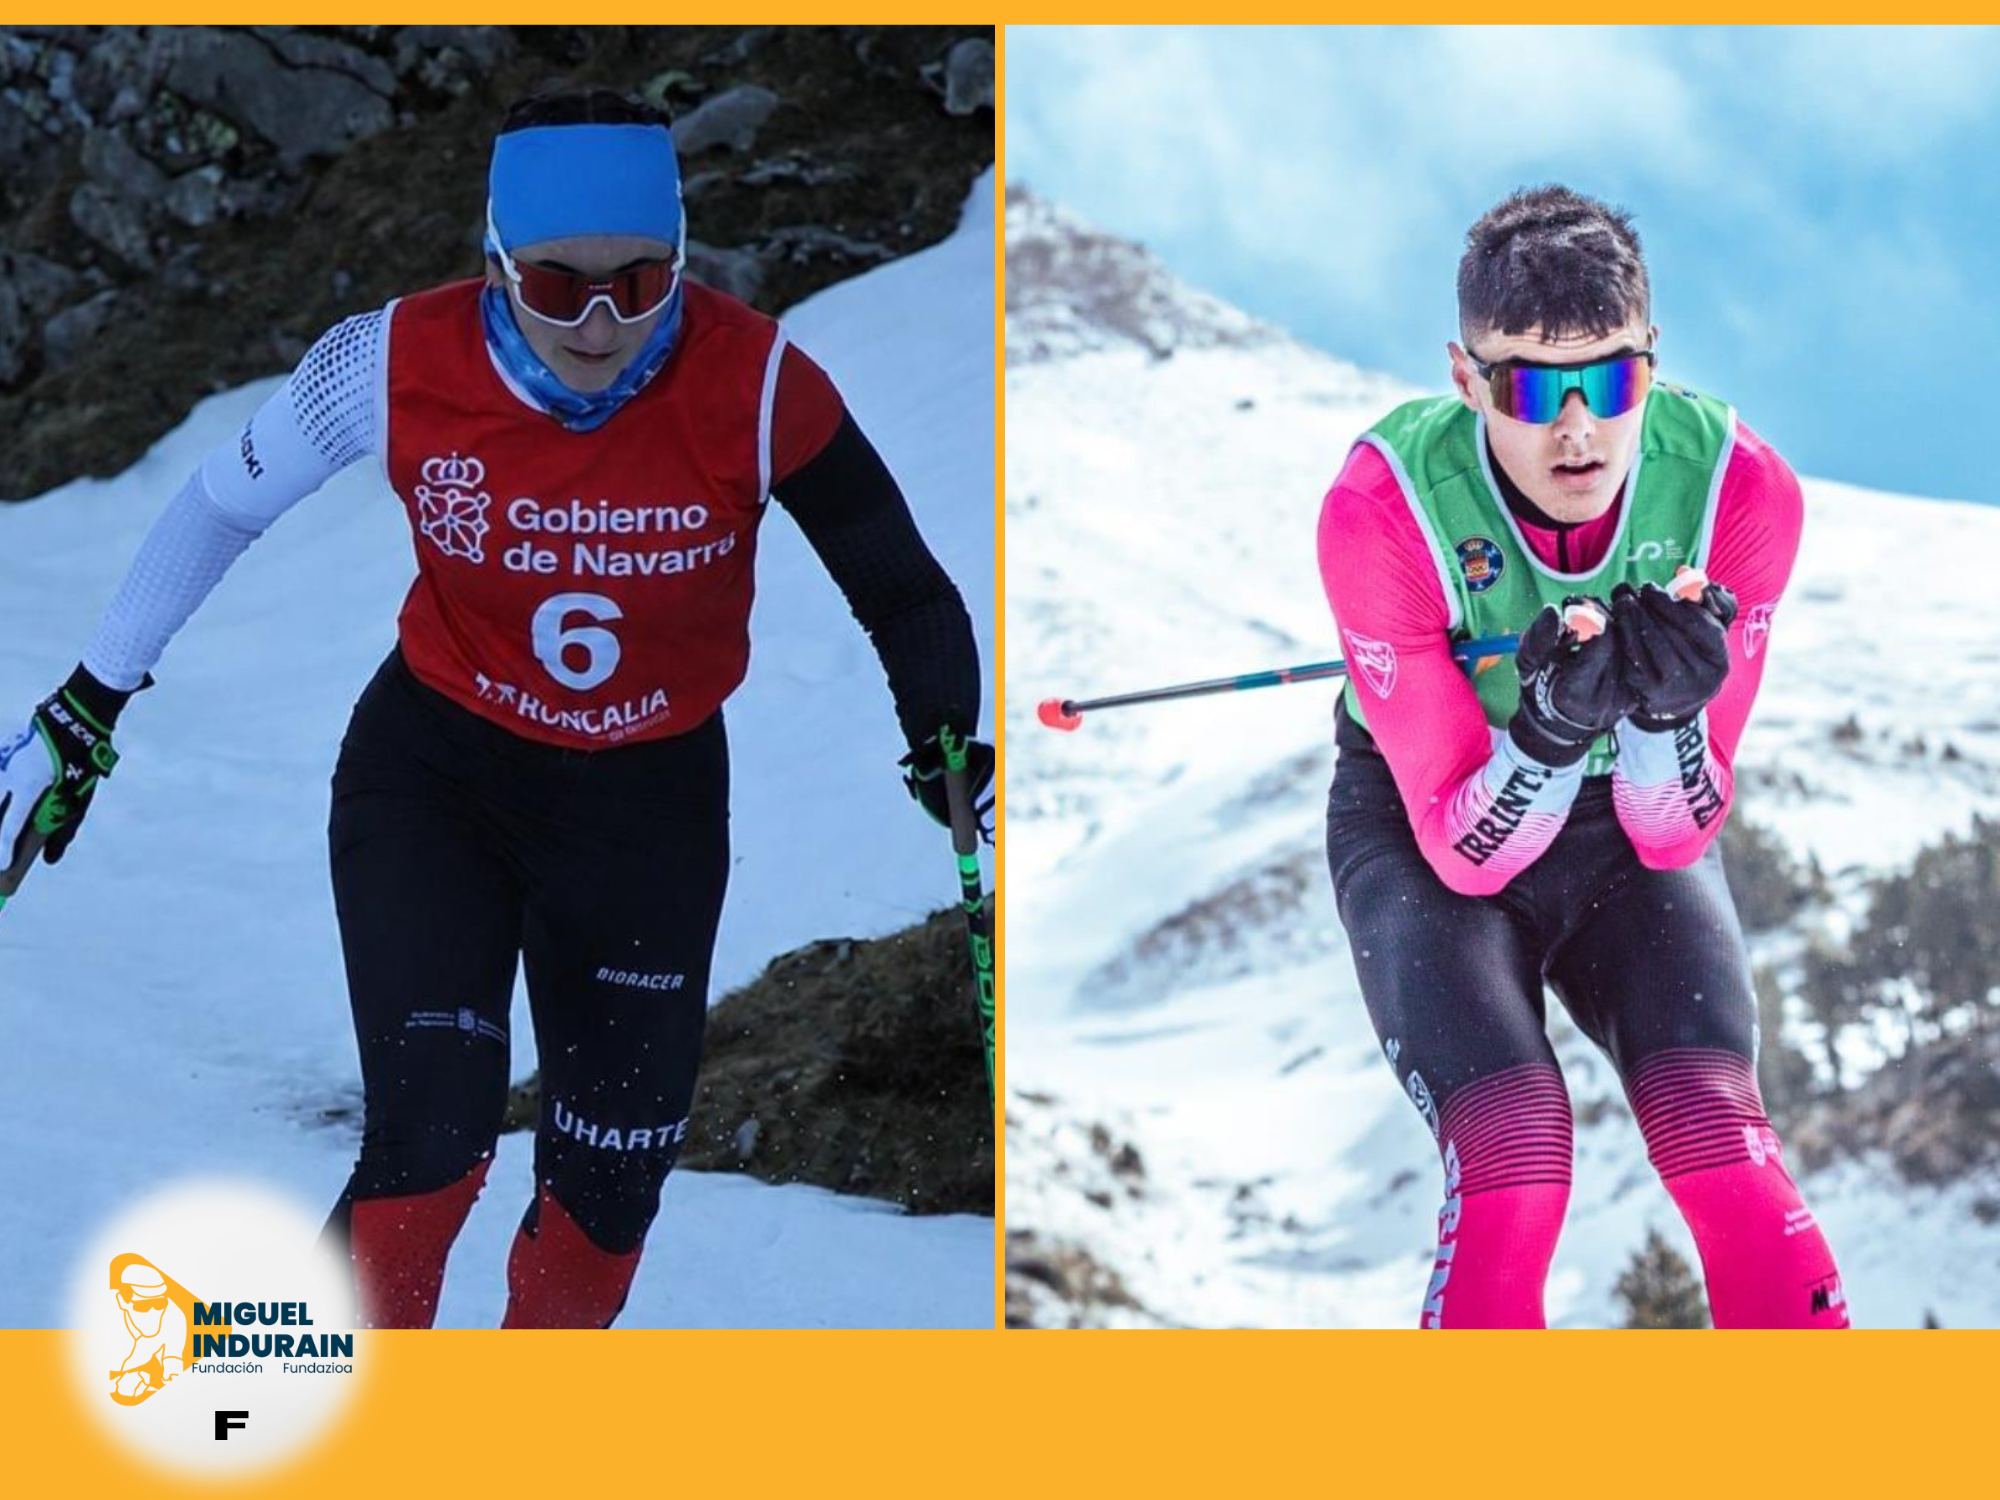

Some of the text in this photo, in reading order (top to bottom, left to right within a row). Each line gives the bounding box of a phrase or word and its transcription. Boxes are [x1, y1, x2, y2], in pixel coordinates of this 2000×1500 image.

[507, 497, 709, 534] Gobierno
[503, 531, 736, 576] de Navarra
[530, 591, 624, 691] 6
[1452, 765, 1553, 867] IRRINT
[597, 967, 685, 991] BIORACER
[554, 1101, 690, 1151] UHARTE
